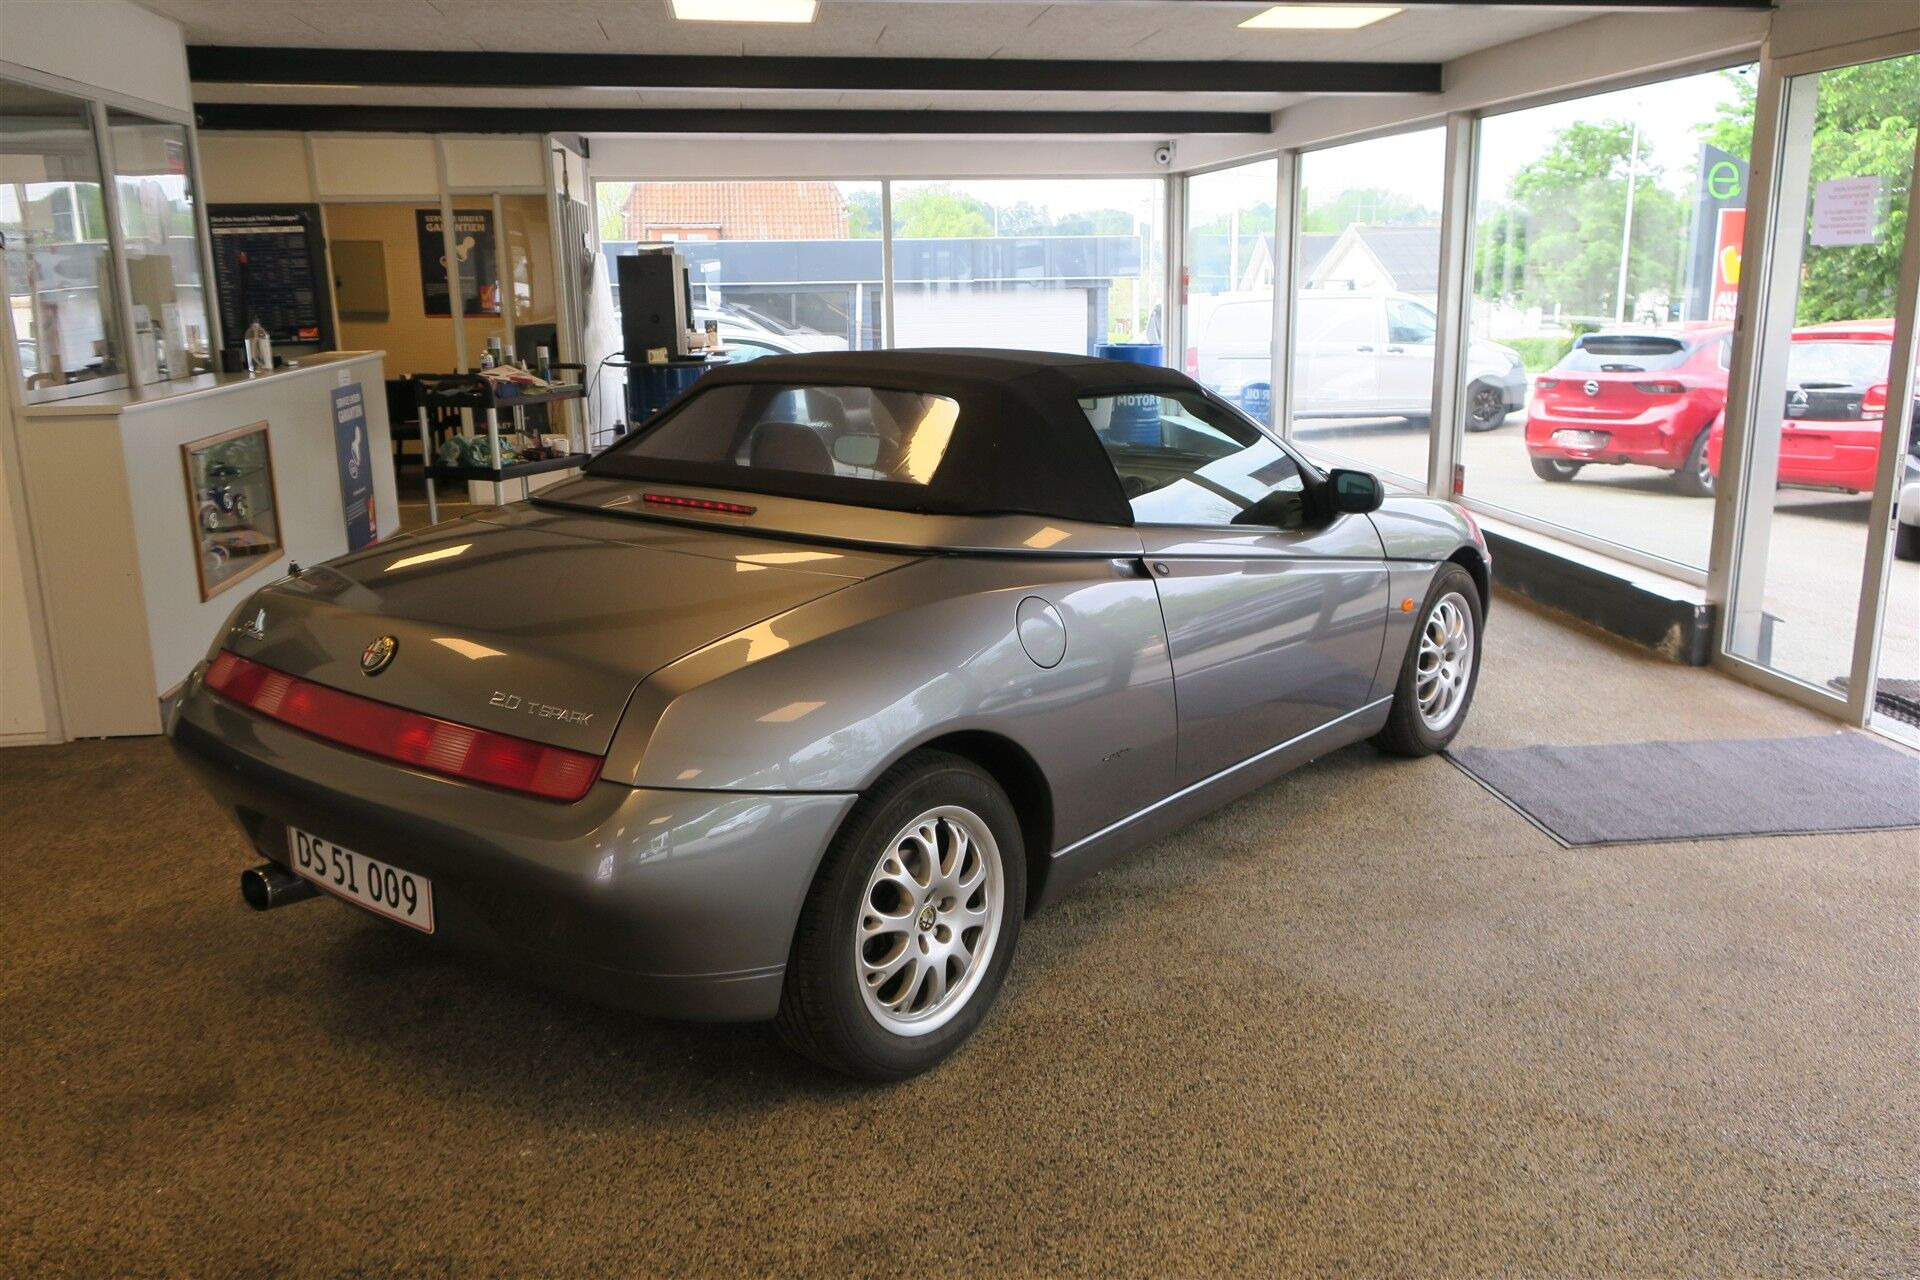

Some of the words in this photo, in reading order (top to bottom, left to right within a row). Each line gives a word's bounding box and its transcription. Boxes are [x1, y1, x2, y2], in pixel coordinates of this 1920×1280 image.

[1716, 291, 1738, 305] AU
[1116, 394, 1156, 406] MOTOR
[296, 830, 326, 877] DS
[331, 845, 359, 894] 51
[367, 861, 418, 916] 009
